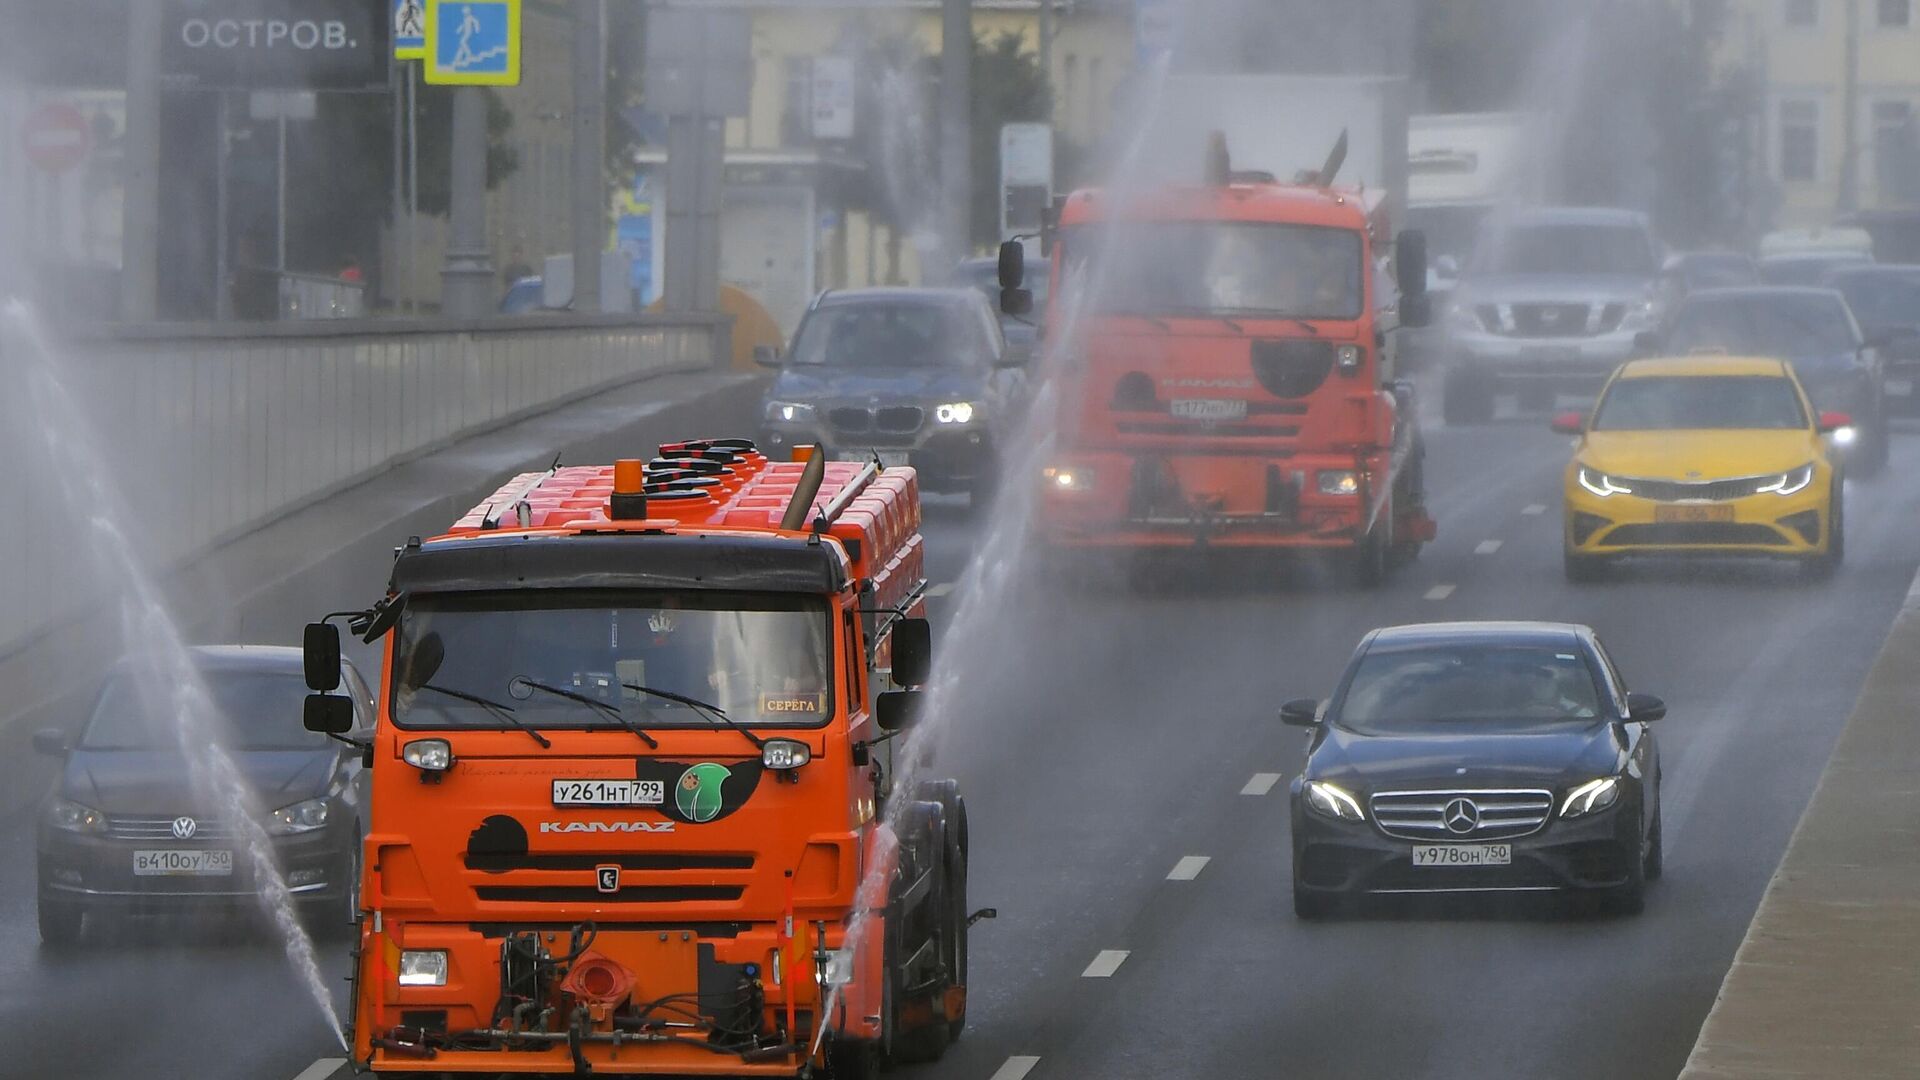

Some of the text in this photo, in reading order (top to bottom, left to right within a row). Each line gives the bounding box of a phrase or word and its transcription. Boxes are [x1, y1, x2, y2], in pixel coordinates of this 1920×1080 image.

[182, 19, 357, 49] ОСТРОВ.
[767, 698, 815, 712] СЕРЁГА
[540, 821, 675, 833] KAMAZ
